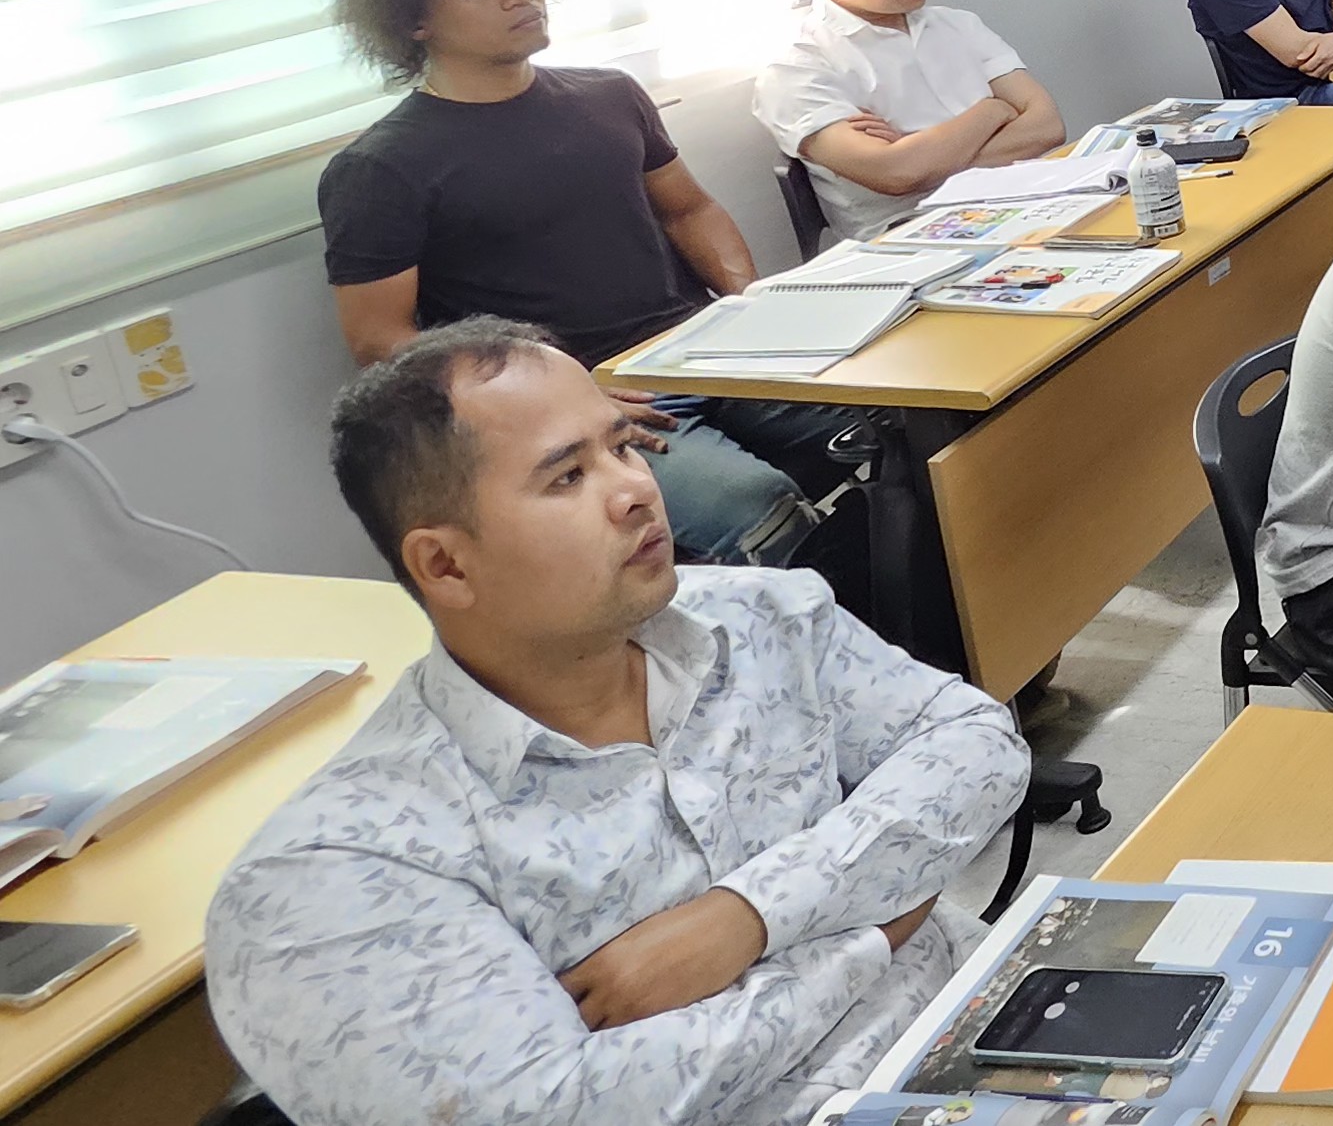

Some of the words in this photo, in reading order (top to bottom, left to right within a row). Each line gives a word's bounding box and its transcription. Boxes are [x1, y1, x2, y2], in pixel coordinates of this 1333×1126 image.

[1253, 926, 1293, 957] 16
[1219, 975, 1257, 1024] 기후와
[1191, 1029, 1225, 1063] 날씨
